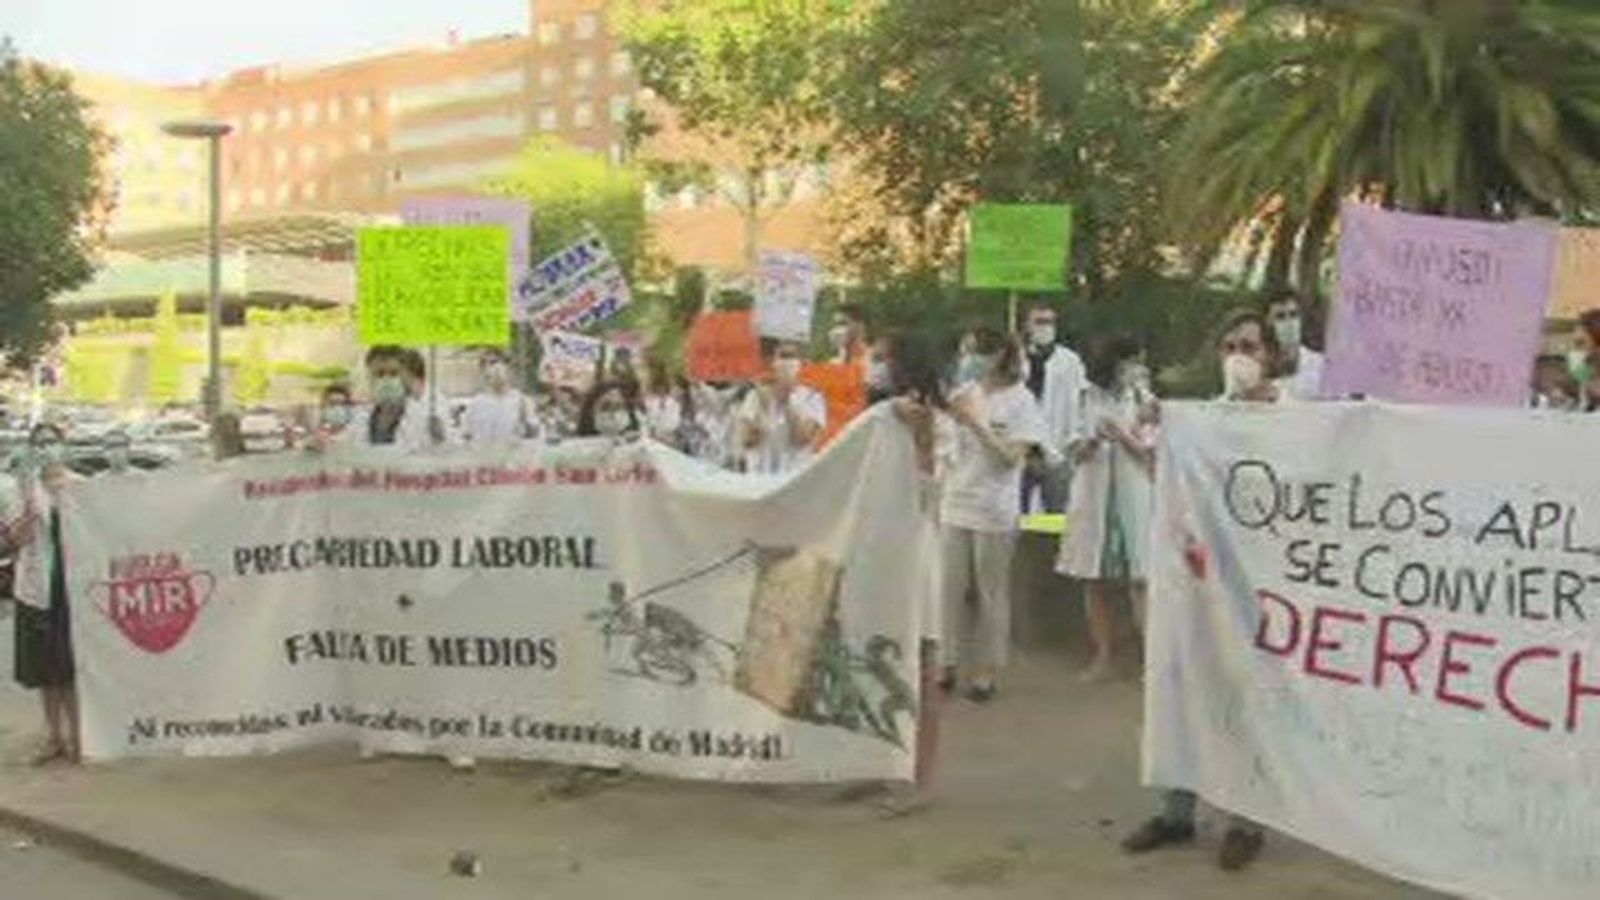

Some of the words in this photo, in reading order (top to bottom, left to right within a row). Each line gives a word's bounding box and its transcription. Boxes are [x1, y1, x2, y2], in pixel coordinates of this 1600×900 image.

[1348, 473, 1451, 537] LOS
[451, 535, 604, 570] LABORAL
[1284, 540, 1342, 586] SE
[118, 582, 187, 618] MIR
[373, 633, 416, 666] DE
[426, 634, 558, 670] MEDIOS
